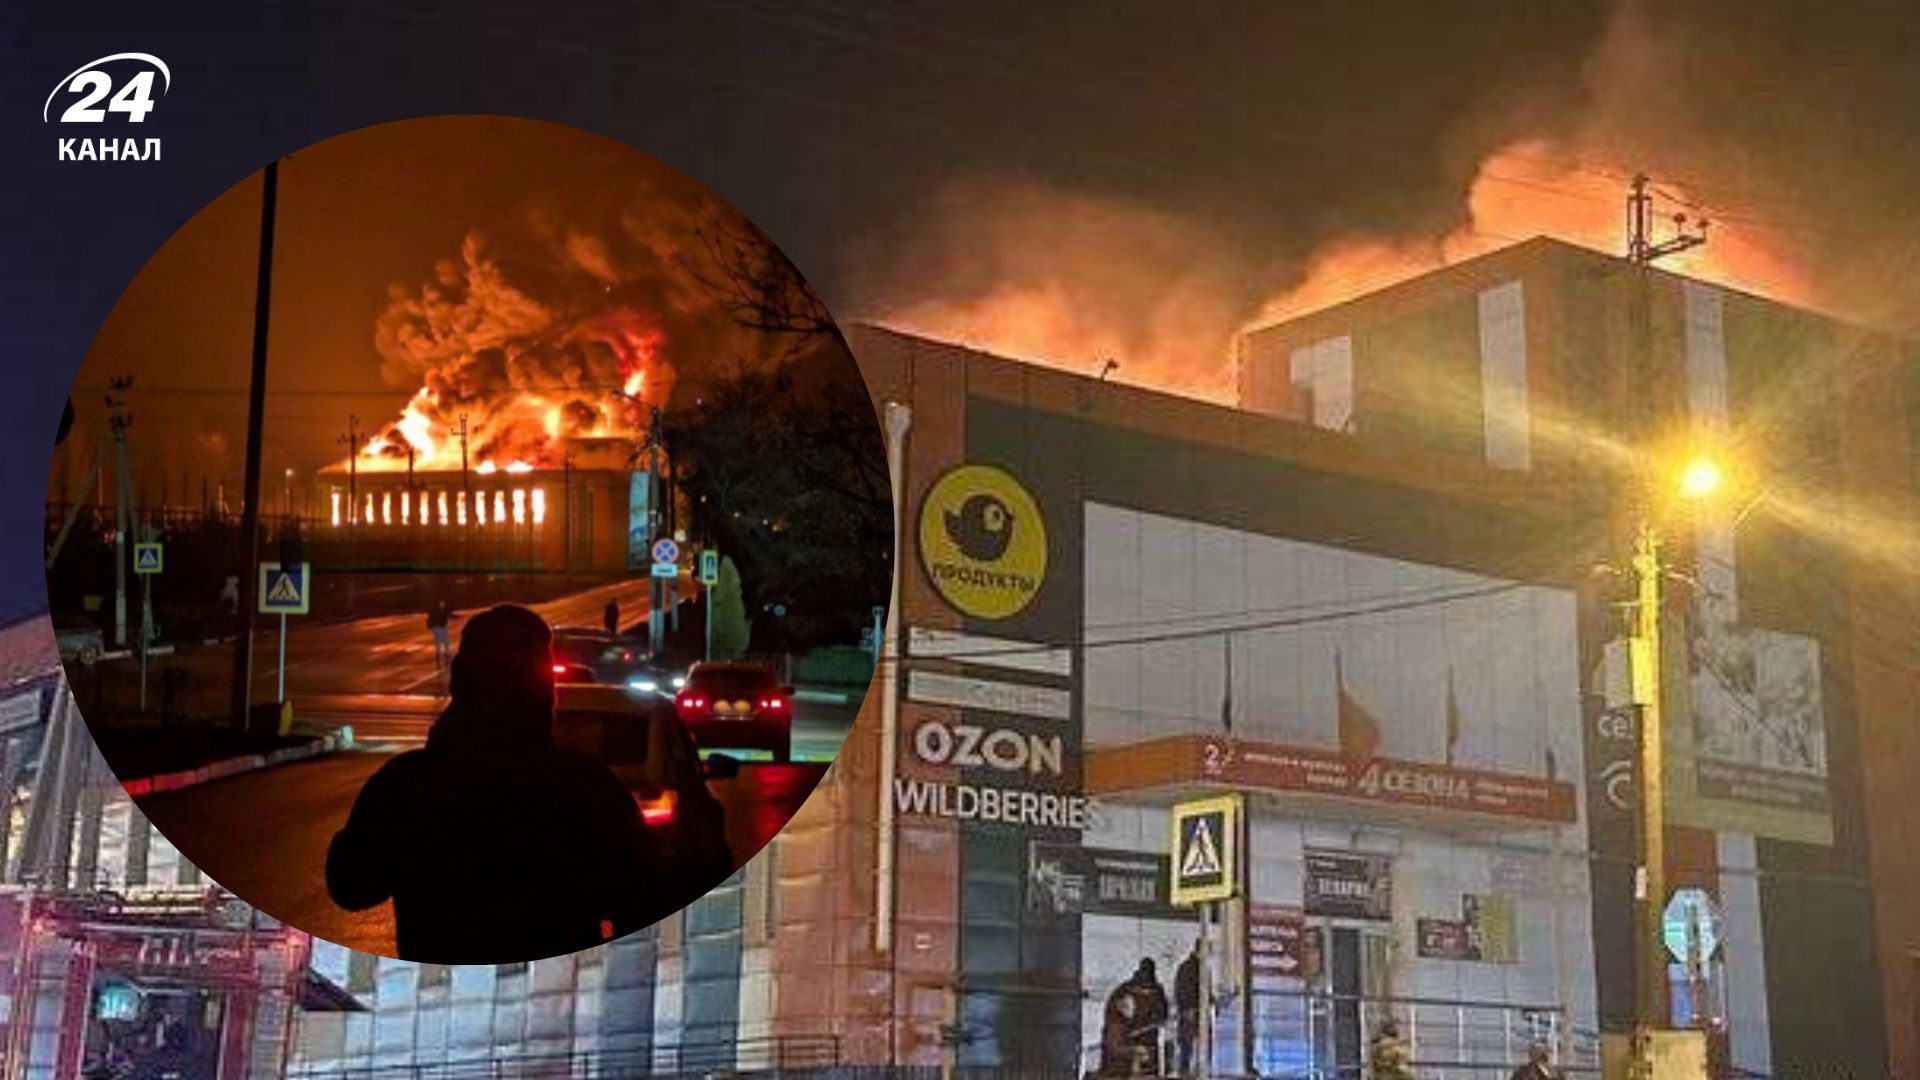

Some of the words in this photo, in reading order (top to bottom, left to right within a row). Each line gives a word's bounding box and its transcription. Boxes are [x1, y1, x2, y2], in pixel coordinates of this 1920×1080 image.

[931, 563, 1036, 591] ПРОДУКТЫ
[916, 721, 1062, 775] OZON
[895, 777, 1101, 832] WILDBERRIES
[1358, 763, 1382, 797] 4
[1383, 768, 1470, 803] СЕЗОНА
